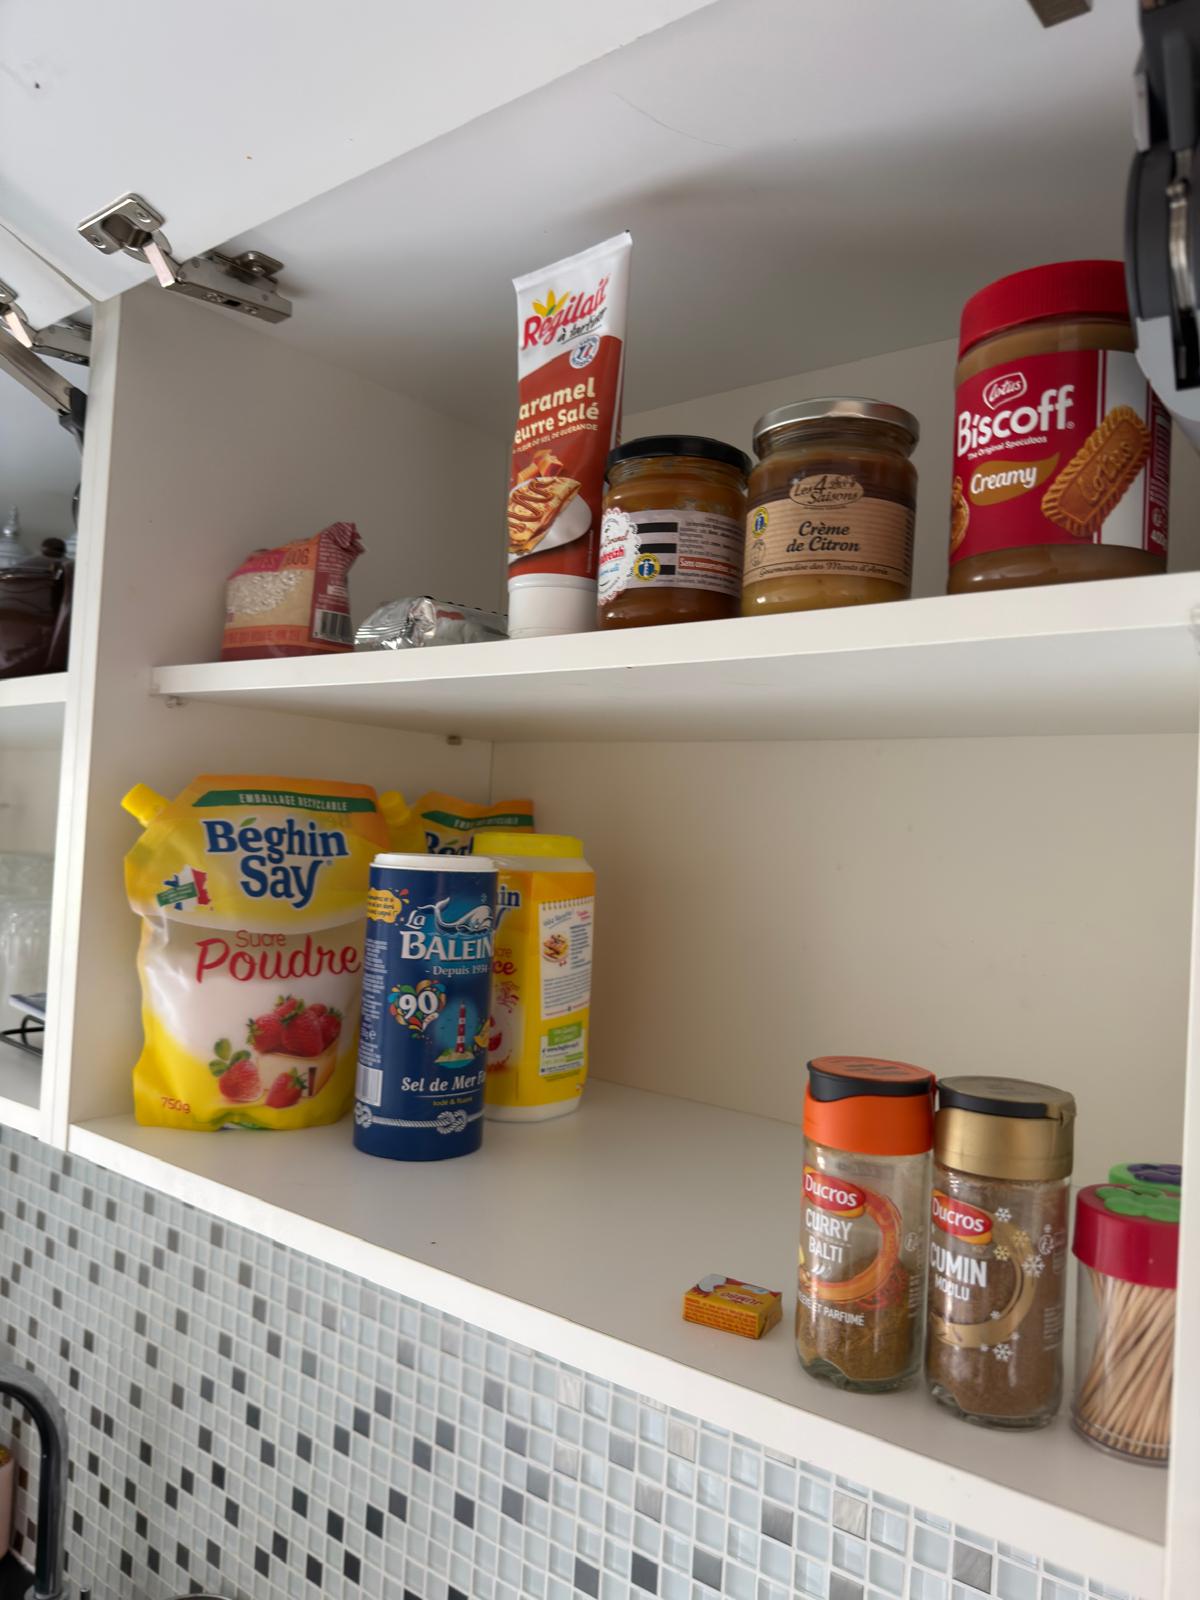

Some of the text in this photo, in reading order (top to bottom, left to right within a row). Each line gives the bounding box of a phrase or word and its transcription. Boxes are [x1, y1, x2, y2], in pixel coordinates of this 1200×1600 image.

[519, 377, 596, 420] aramel
[988, 378, 1022, 402] Lotus
[514, 402, 600, 444] eurre Salé
[957, 384, 1075, 458] Biscoff
[970, 466, 1038, 495] Creamy
[799, 520, 850, 537] Crème
[786, 536, 860, 553] de Citron
[239, 793, 296, 806] EMBALLAGE
[202, 817, 349, 864] Béghin
[240, 855, 324, 909] Say
[405, 909, 427, 930] La
[235, 929, 287, 948] Sucre
[399, 930, 494, 961] BALEIN
[194, 934, 362, 984] Poudre
[432, 964, 470, 978] Depuis
[398, 989, 440, 1021] 90
[401, 1077, 424, 1092] Sel
[429, 1078, 448, 1092] de
[452, 1074, 477, 1091] Mer
[805, 1174, 858, 1208] Ducros
[806, 1208, 853, 1243] CURRY
[932, 1197, 985, 1233] Ducros
[809, 1236, 843, 1264] BALTI
[931, 1242, 988, 1288] CUMIN
